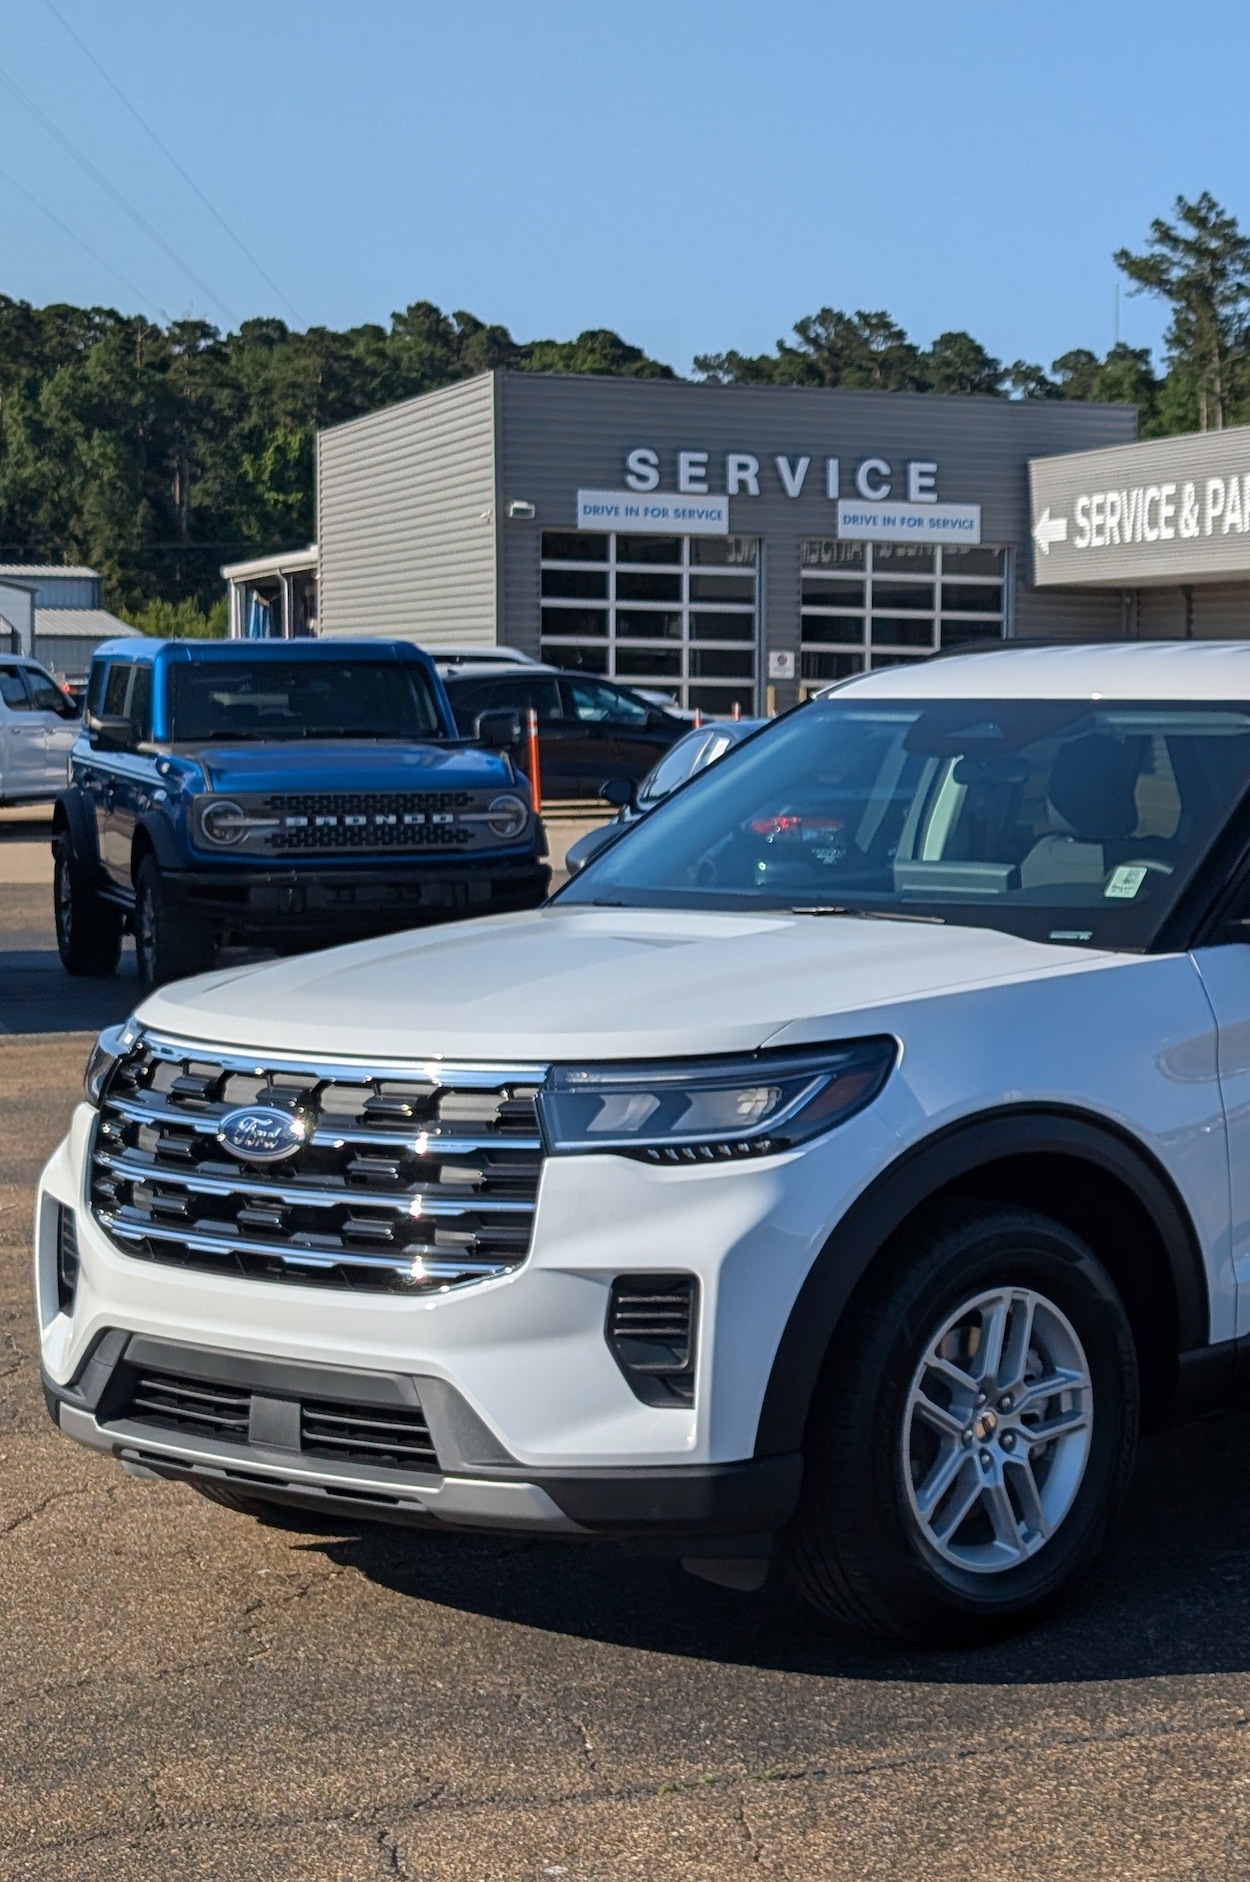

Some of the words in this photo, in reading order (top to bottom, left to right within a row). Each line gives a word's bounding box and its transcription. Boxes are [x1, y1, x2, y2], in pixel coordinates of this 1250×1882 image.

[625, 448, 938, 503] SERVICE
[583, 504, 620, 517] DRIVE
[625, 506, 640, 518] IN
[644, 506, 669, 519] FOR
[673, 508, 723, 521] SERVICE
[843, 514, 878, 527] DRIVE
[883, 515, 896, 528] IN
[901, 516, 925, 529] FOR
[929, 517, 975, 530] SERVICE
[1073, 483, 1176, 549] SERVICE
[1178, 481, 1200, 538] &
[286, 814, 454, 827] BRONCO
[233, 1116, 282, 1149] Ford
